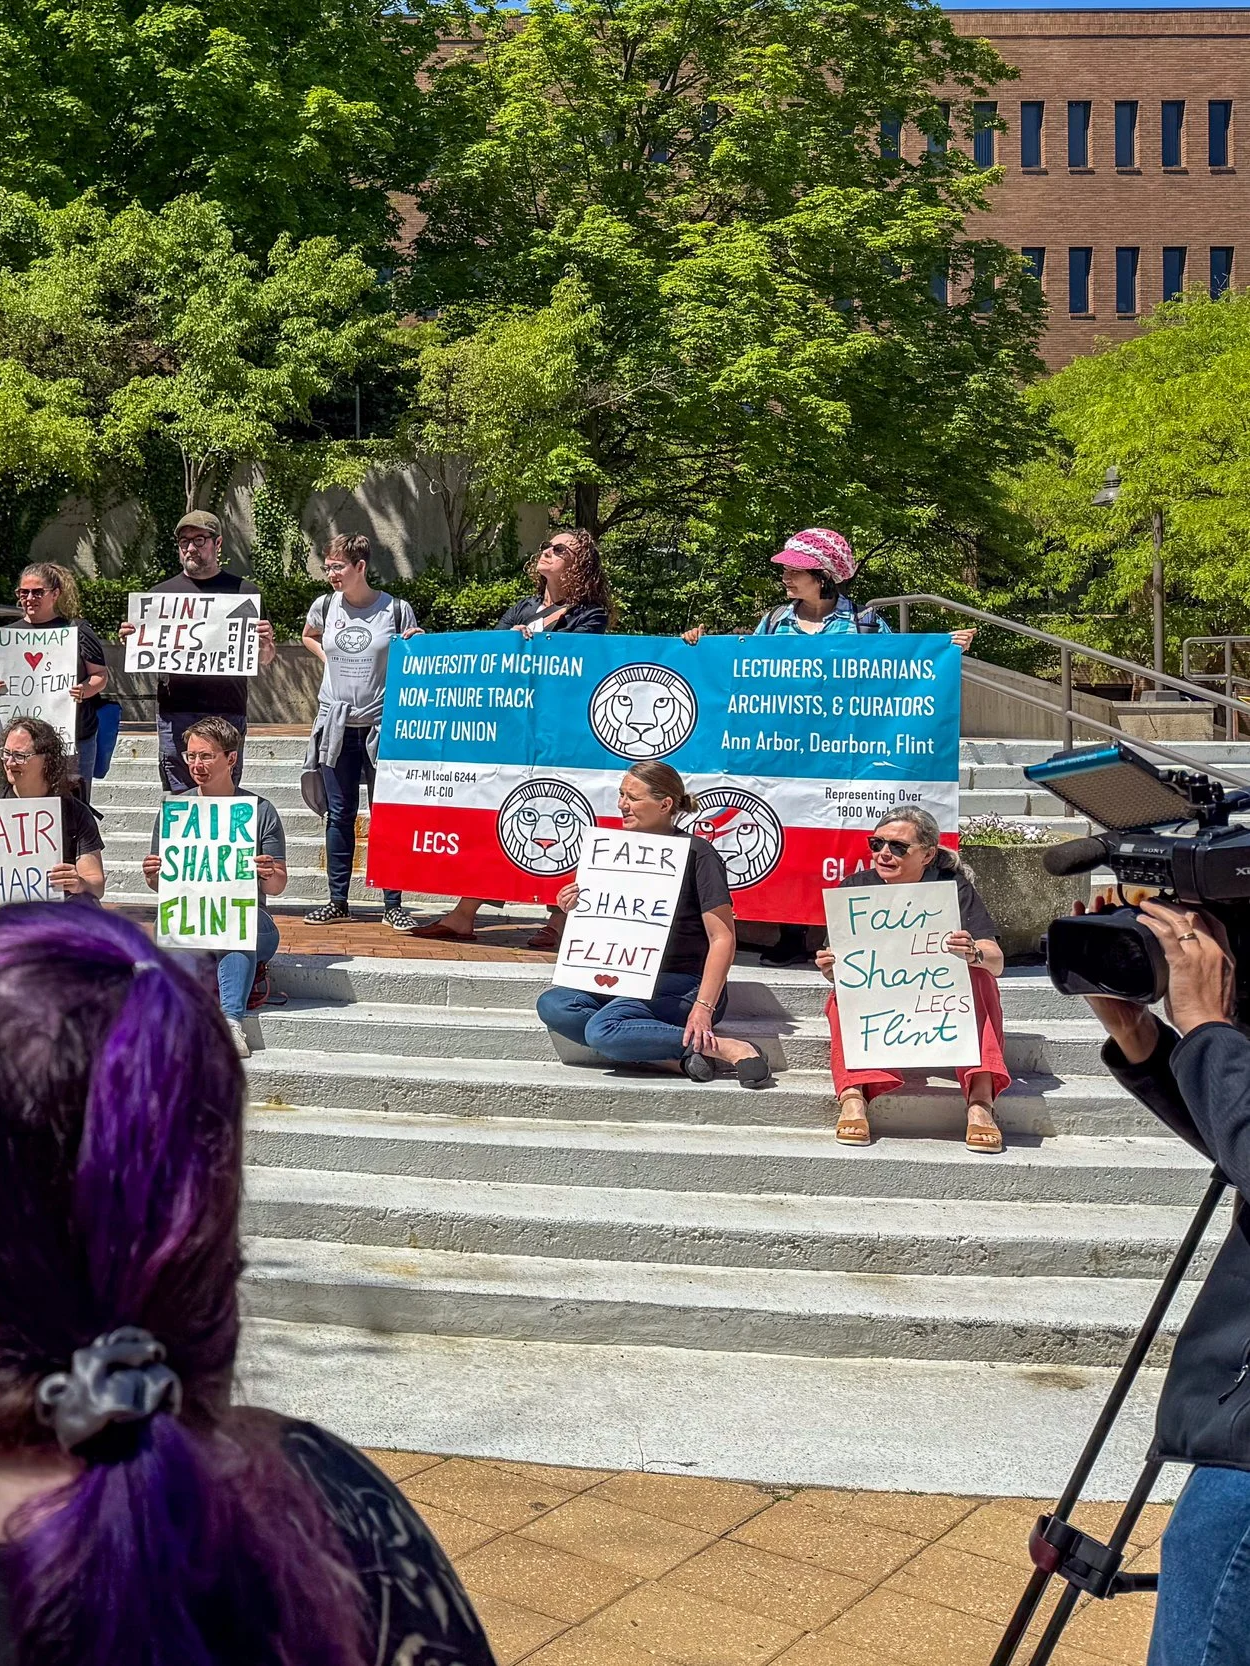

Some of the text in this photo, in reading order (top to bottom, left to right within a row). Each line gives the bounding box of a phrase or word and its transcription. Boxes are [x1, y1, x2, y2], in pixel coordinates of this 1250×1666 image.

[139, 597, 215, 620] FLINT
[137, 621, 206, 651] LECS
[227, 622, 239, 669] MORE
[137, 650, 227, 673] DESERVE
[402, 653, 584, 677] UNIVERSITY OF MICHIGAN
[733, 658, 937, 681] LECTURERS, LIBRARIANS,
[398, 687, 535, 709] NON-TENURE TRACK
[727, 694, 935, 718] ARCHIVISTS, & CURATORS
[394, 719, 497, 742] FACULTY UNION
[720, 729, 935, 757] Ann Arbor, Dearborn, Flint
[405, 769, 477, 783] AFT-MI Local 6244
[423, 785, 454, 798] AFL-CIO
[825, 787, 923, 805] Representing Over
[161, 801, 255, 843] FAIR
[836, 806, 863, 818] 1800
[412, 830, 460, 855] LECS
[591, 838, 677, 872] FAIR
[160, 845, 255, 882] SHARE
[576, 888, 671, 920] SHARE
[848, 896, 943, 935] Fair
[160, 896, 256, 940] FLINT
[566, 939, 660, 971] FLINT
[839, 950, 955, 990] Share
[914, 995, 970, 1013] LECS
[859, 1008, 958, 1051] Flint
